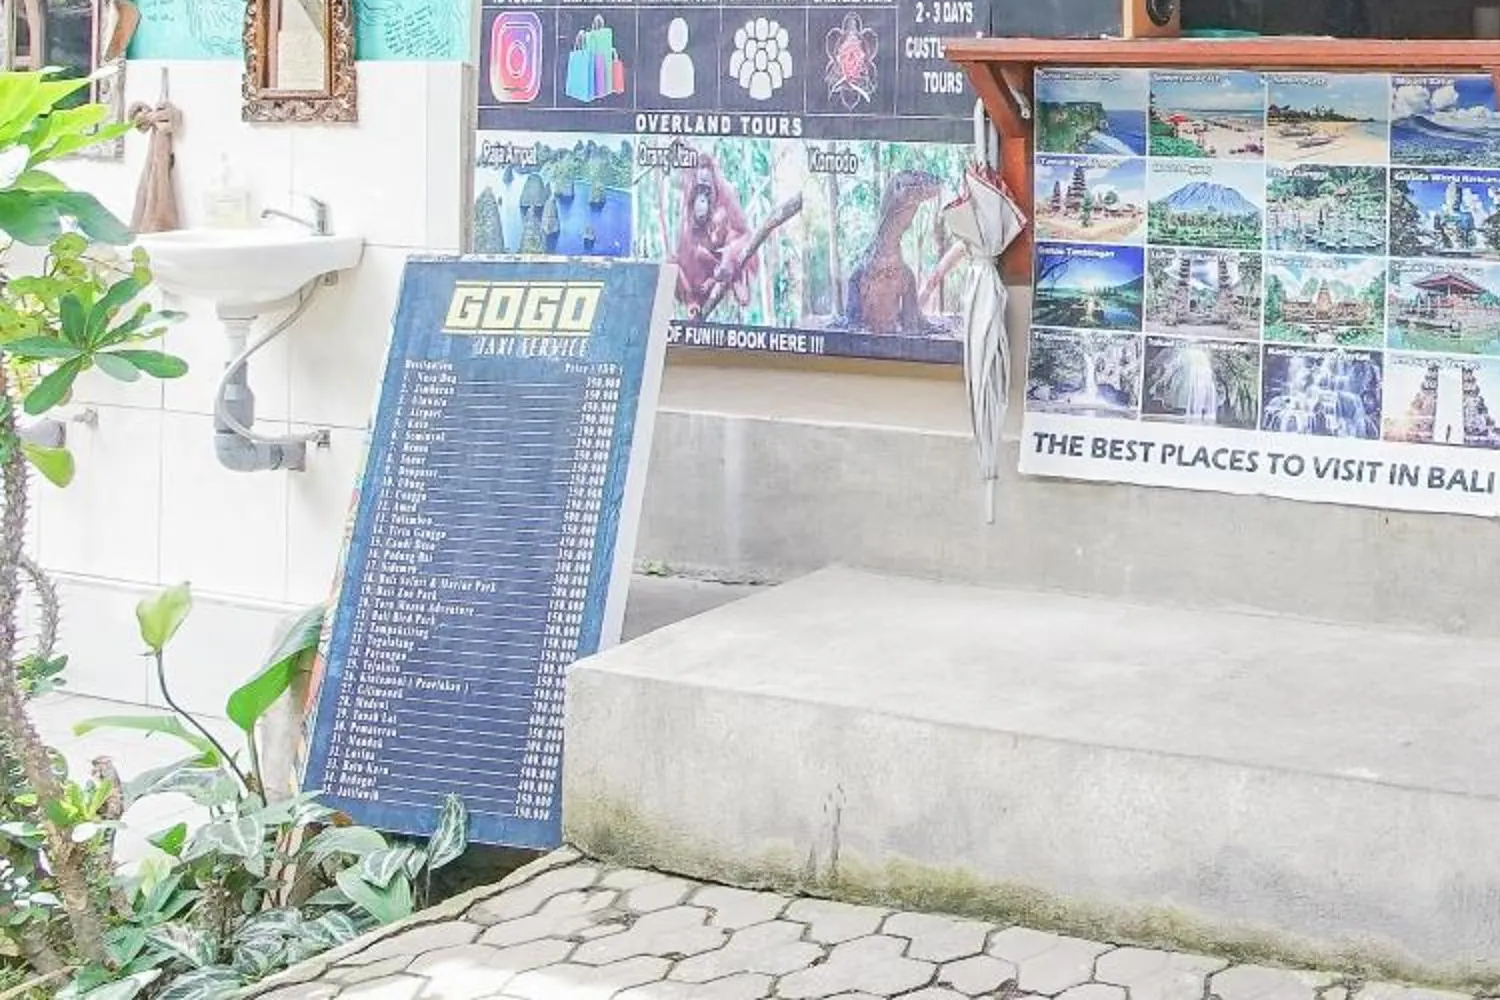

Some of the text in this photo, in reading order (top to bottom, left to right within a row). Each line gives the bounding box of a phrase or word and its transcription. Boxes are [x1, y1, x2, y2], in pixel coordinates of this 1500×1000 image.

[914, 1, 925, 23] 2
[932, 2, 942, 23] 3
[942, 1, 975, 25] DAYS
[922, 72, 964, 94] TOURS
[635, 113, 804, 137] OVERLAND TOURS
[807, 150, 859, 174] Komodo
[444, 280, 604, 335] GOGO
[727, 330, 767, 349] BOOK
[769, 332, 808, 353] HERE
[1033, 431, 1496, 495] THE BEST PLACES TO VISIT IN BALI
